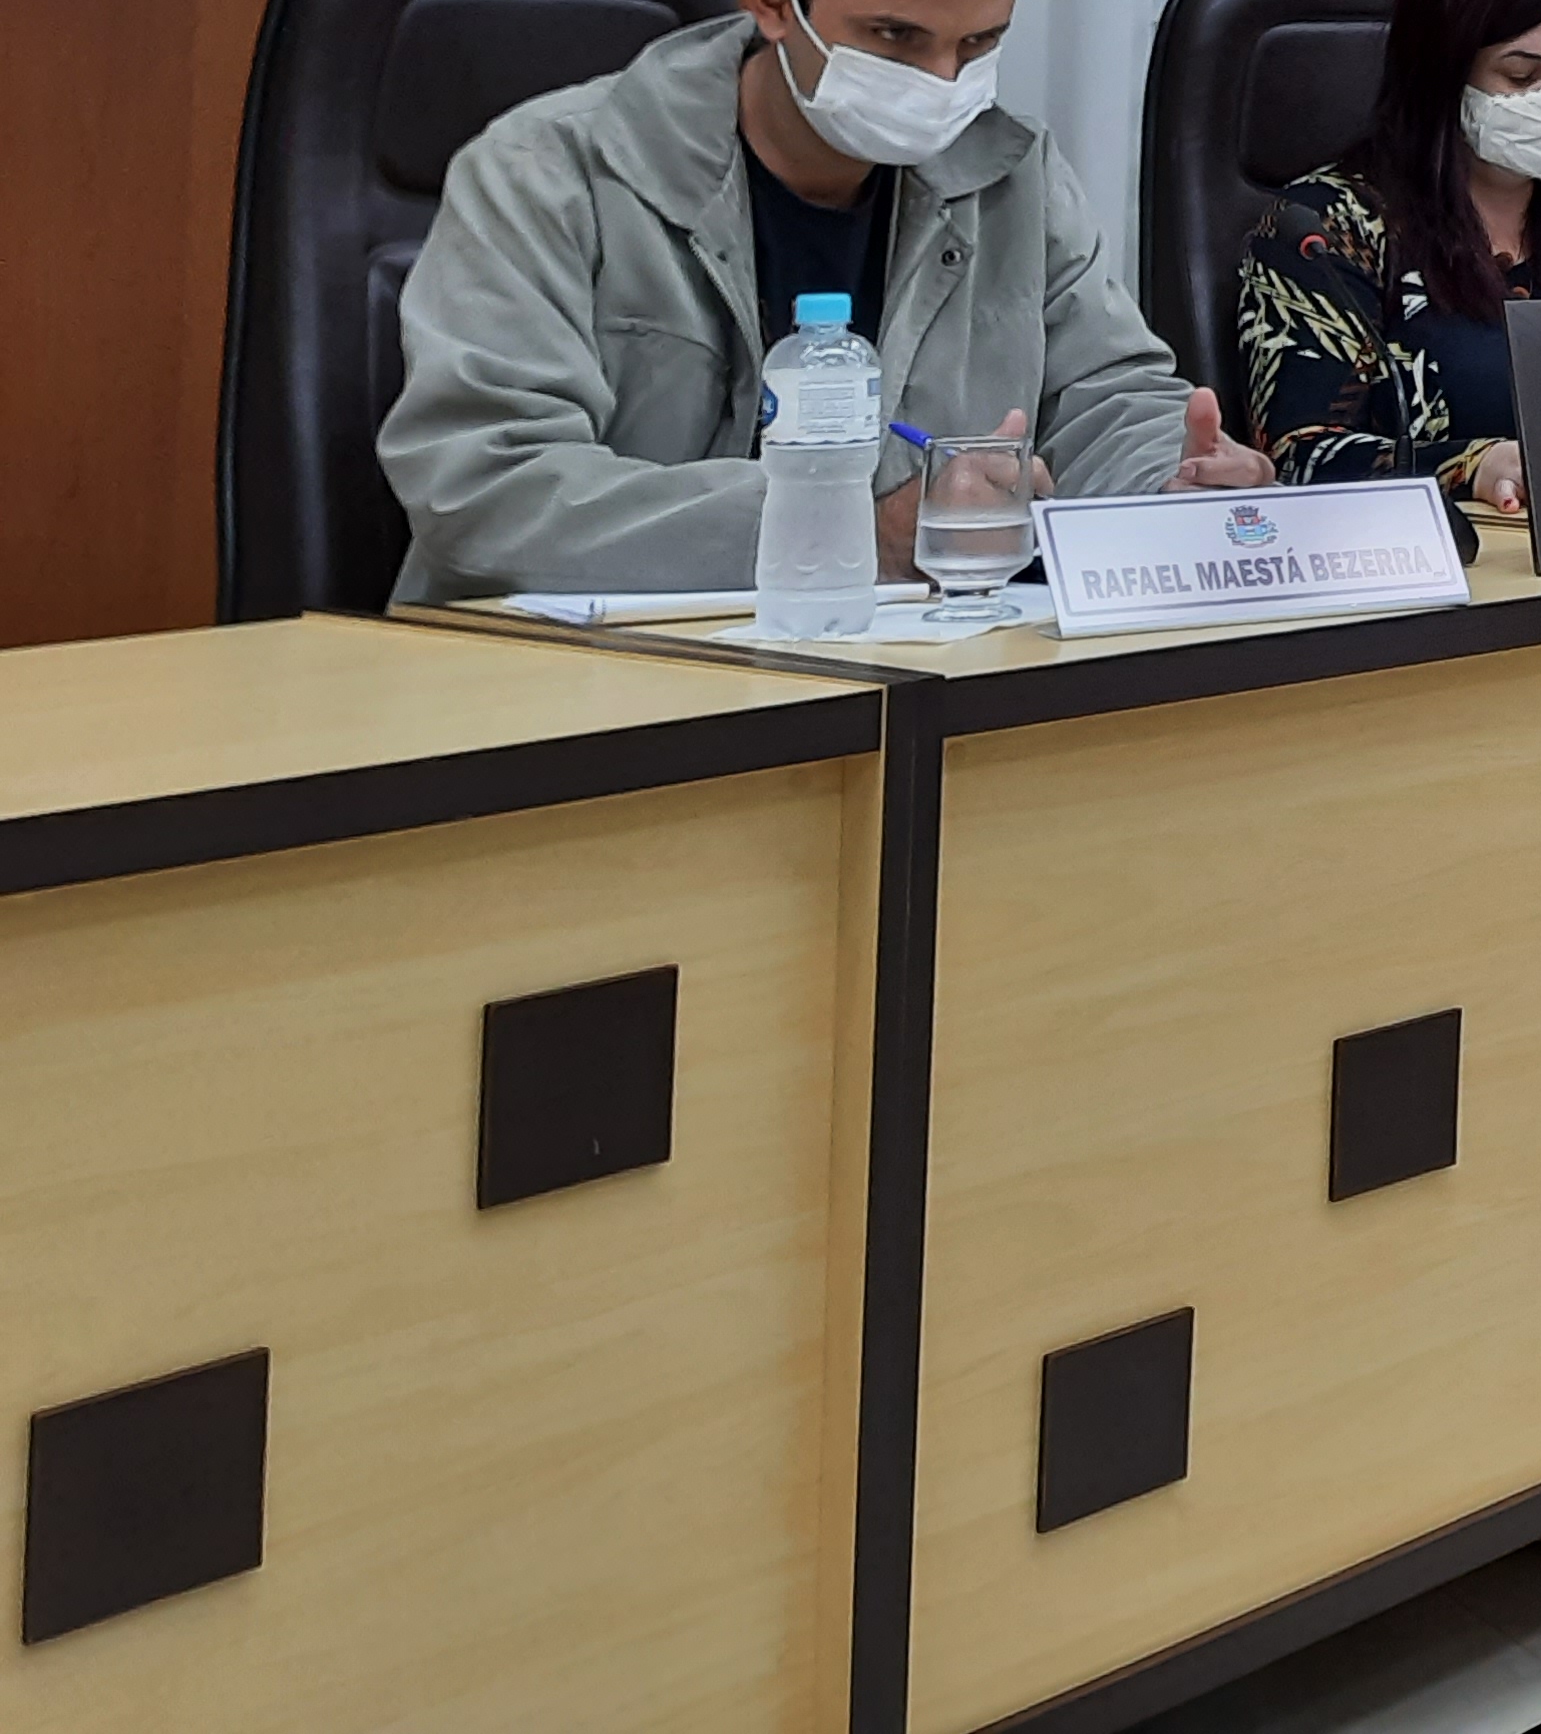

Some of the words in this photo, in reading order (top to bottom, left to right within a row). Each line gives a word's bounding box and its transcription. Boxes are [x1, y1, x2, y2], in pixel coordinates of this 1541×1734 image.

[1081, 565, 1192, 600] RAFAEL
[1200, 547, 1305, 592] MAESTÁ
[1313, 545, 1433, 582] BEZERRA
